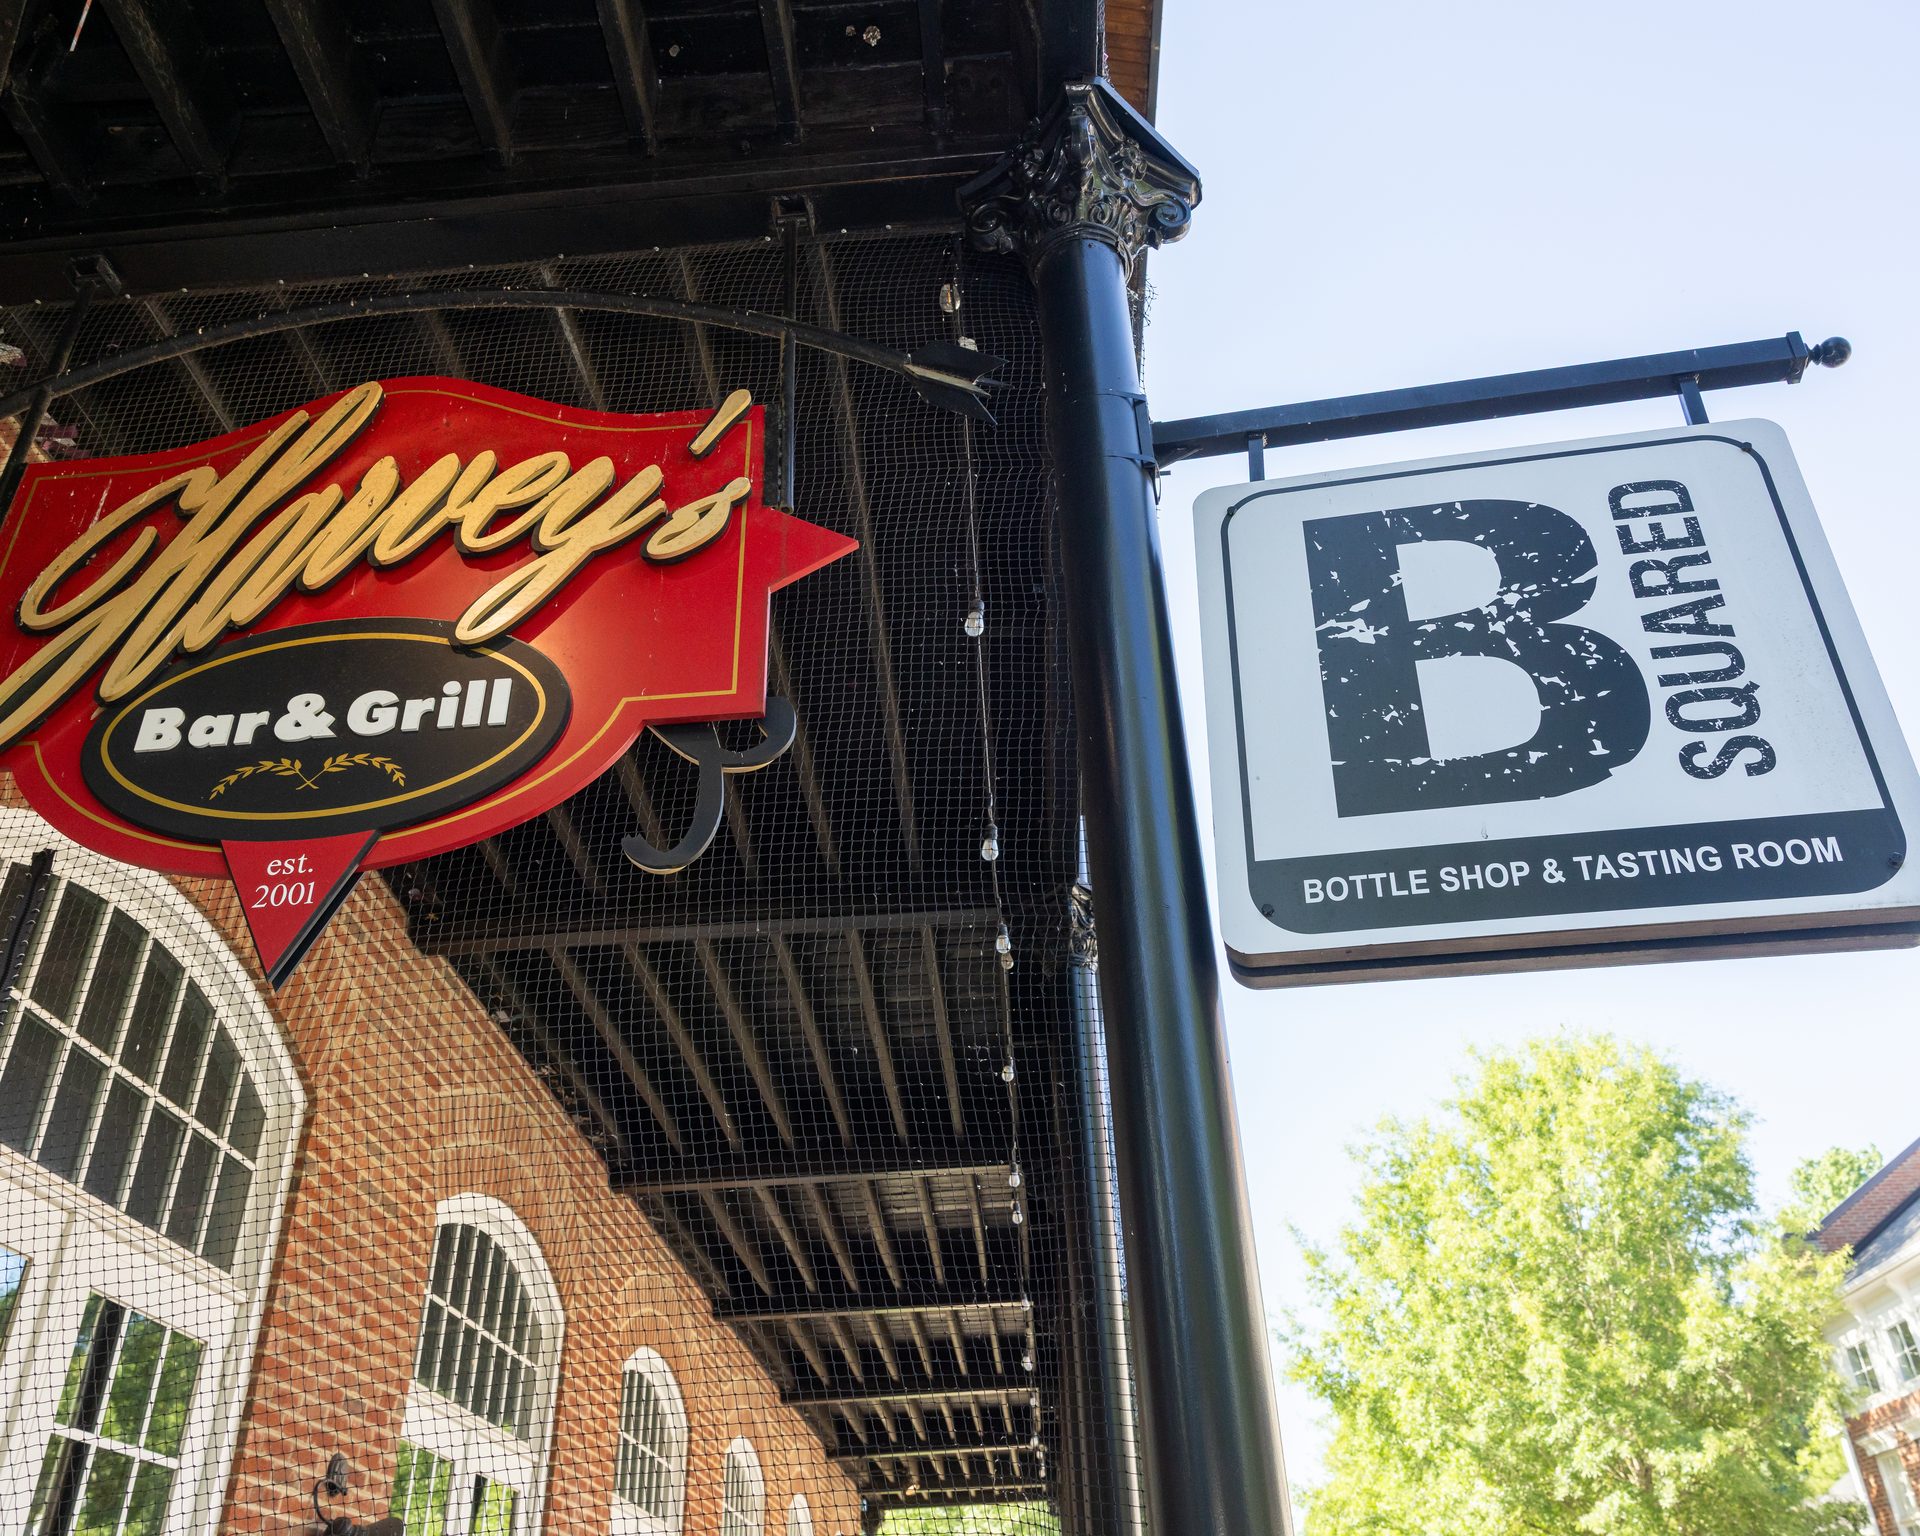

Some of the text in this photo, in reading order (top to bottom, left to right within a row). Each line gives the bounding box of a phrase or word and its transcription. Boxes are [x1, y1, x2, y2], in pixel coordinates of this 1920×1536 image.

[0, 381, 752, 749] Harvey's
[1608, 479, 1776, 780] SQUARED
[1302, 499, 1651, 818] B
[251, 881, 315, 909] 2001
[266, 853, 314, 876] est.
[1303, 836, 1844, 904] BOTTLE SHOP & TASTING ROOM
